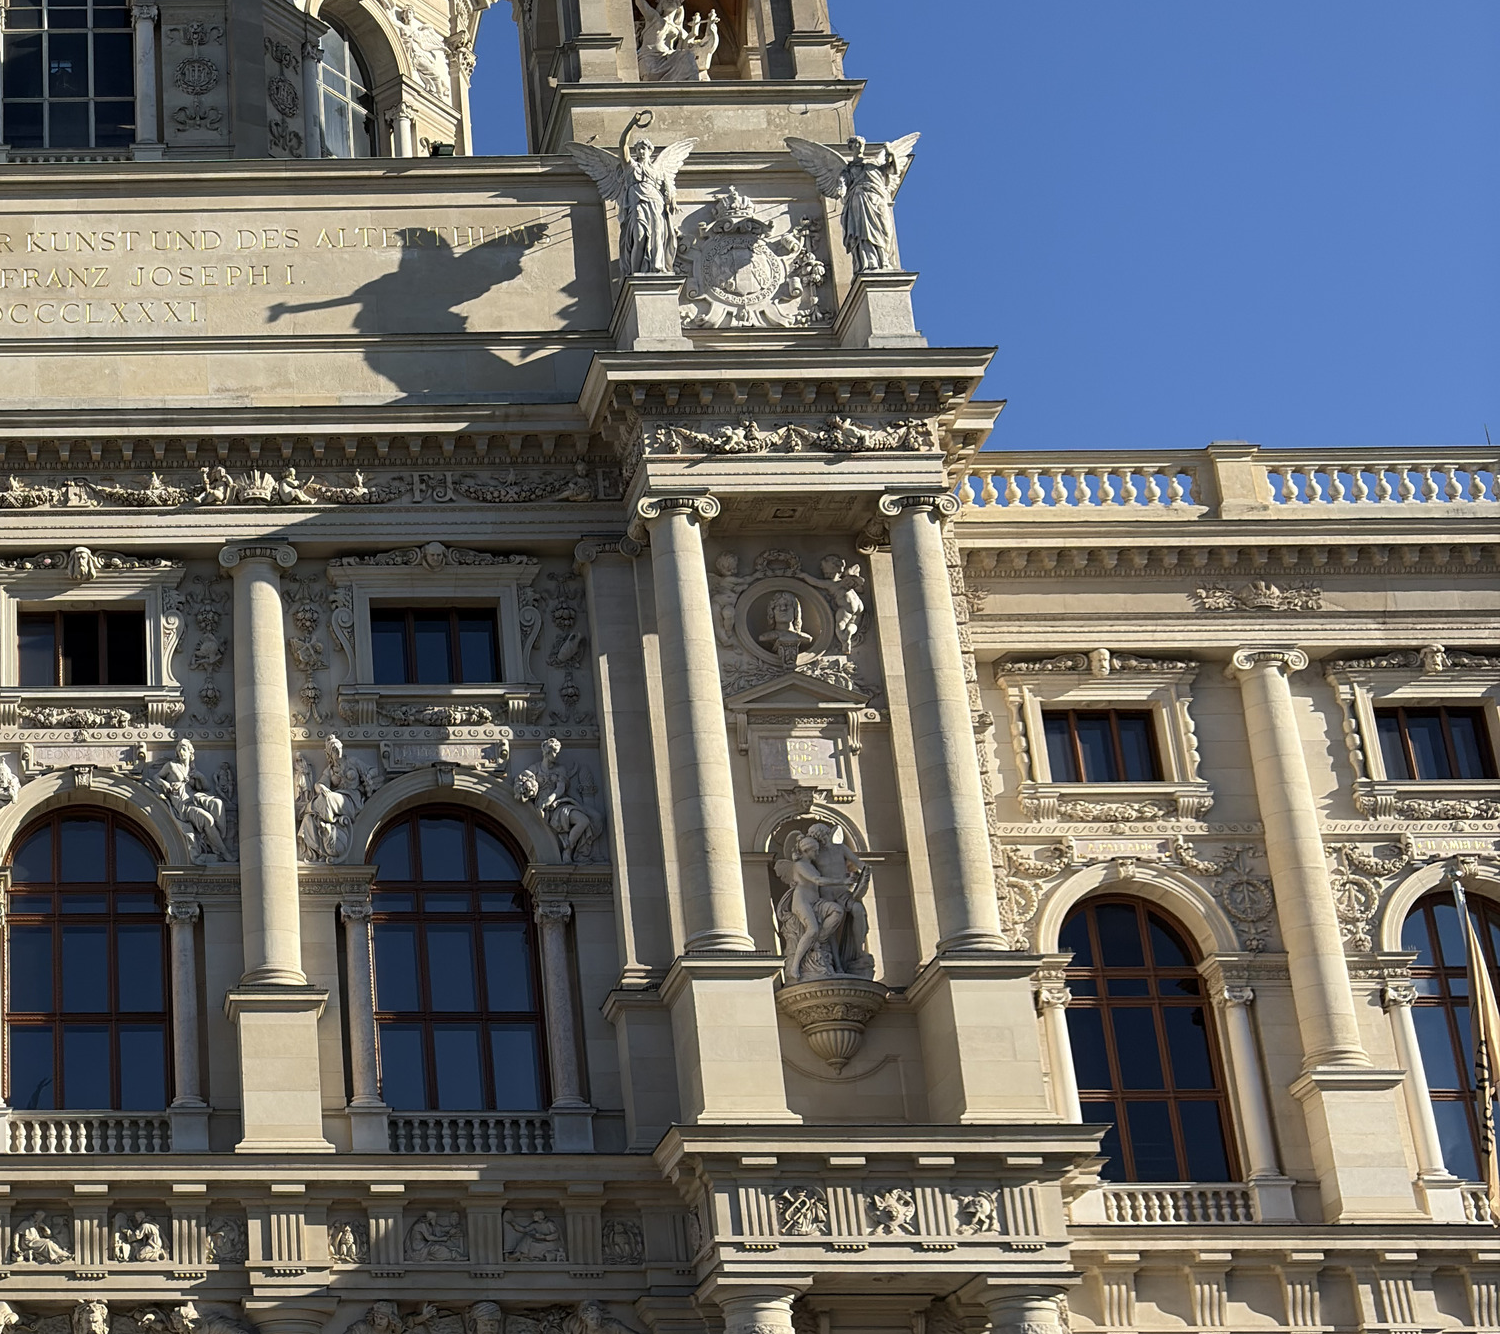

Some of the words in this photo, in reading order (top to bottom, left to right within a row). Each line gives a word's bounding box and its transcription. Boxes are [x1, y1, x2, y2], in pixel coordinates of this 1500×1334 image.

[24, 230, 140, 254] KUNST
[150, 230, 222, 251] UND
[236, 229, 300, 250] DES
[315, 223, 552, 249] ALTERTHUMS
[0, 267, 110, 289] FRANZ
[130, 264, 271, 287] JOSEPH
[284, 264, 306, 286] I.
